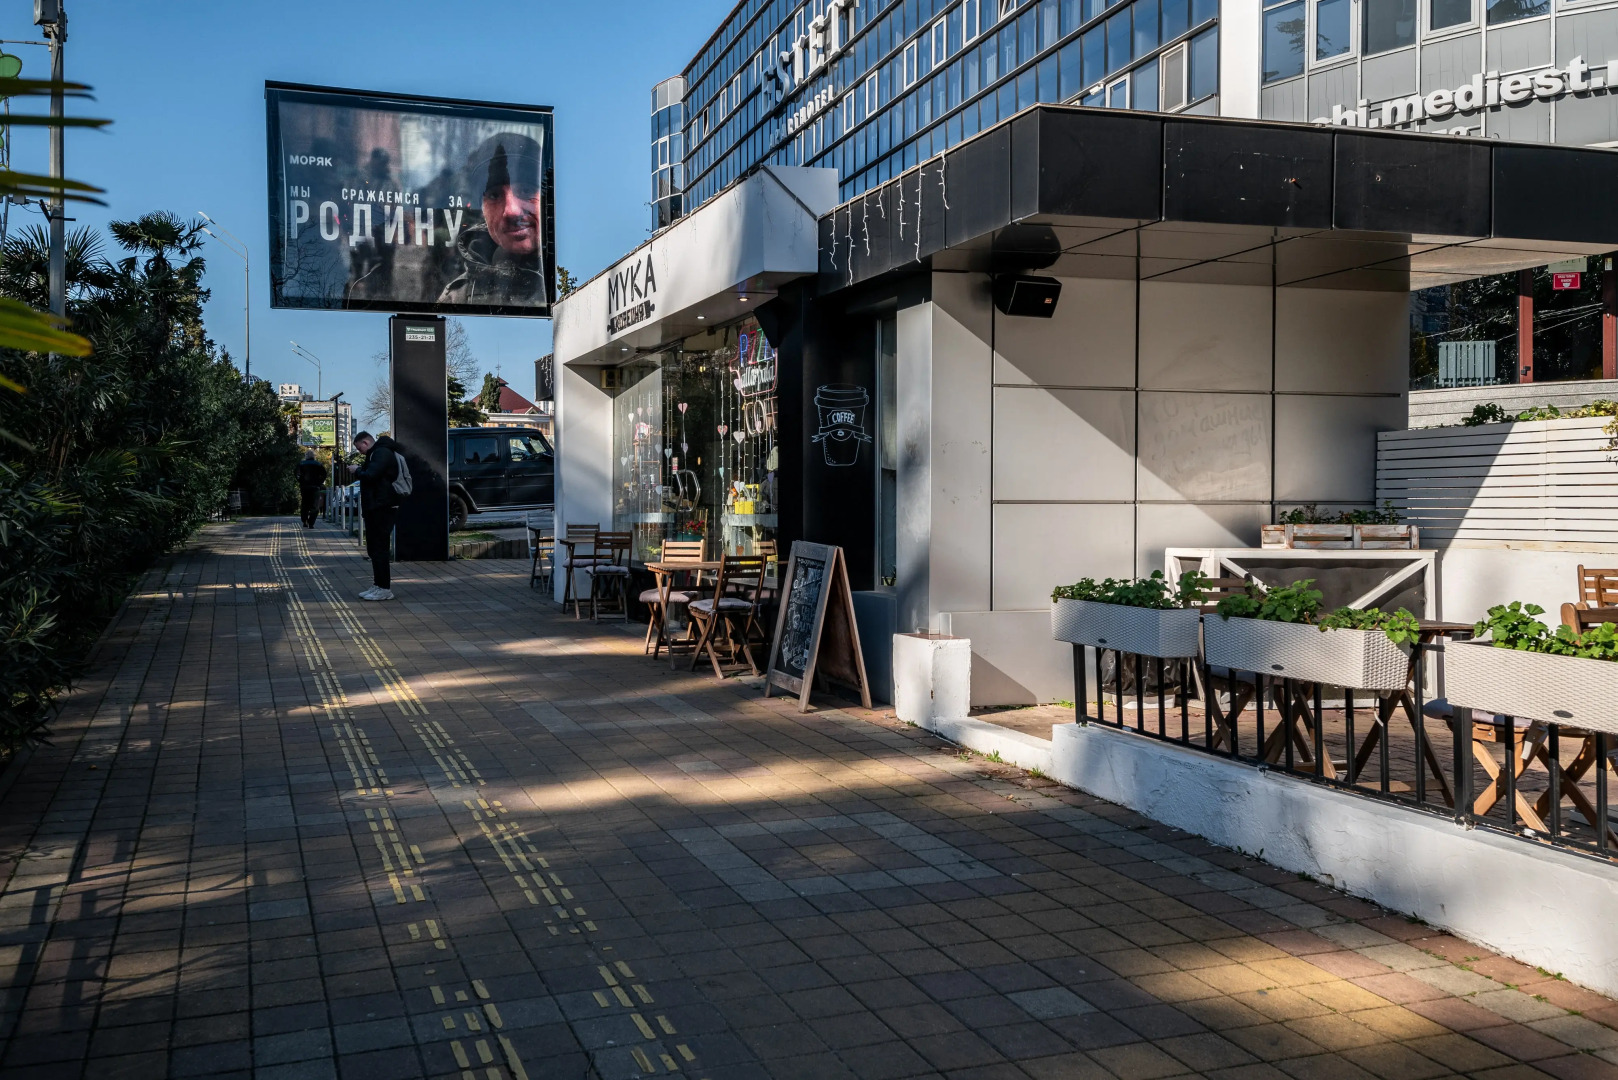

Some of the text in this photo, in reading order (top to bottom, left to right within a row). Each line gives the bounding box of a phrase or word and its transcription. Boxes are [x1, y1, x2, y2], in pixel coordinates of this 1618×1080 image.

[761, 0, 845, 119] ESTET
[1311, 55, 1618, 128] hi.mediest.
[289, 154, 333, 167] МОРЯК
[290, 185, 463, 208] МЫ СРАЖАЕМСЯ ЗА
[290, 199, 464, 248] РОДИНУ
[831, 411, 855, 424] COFFEE
